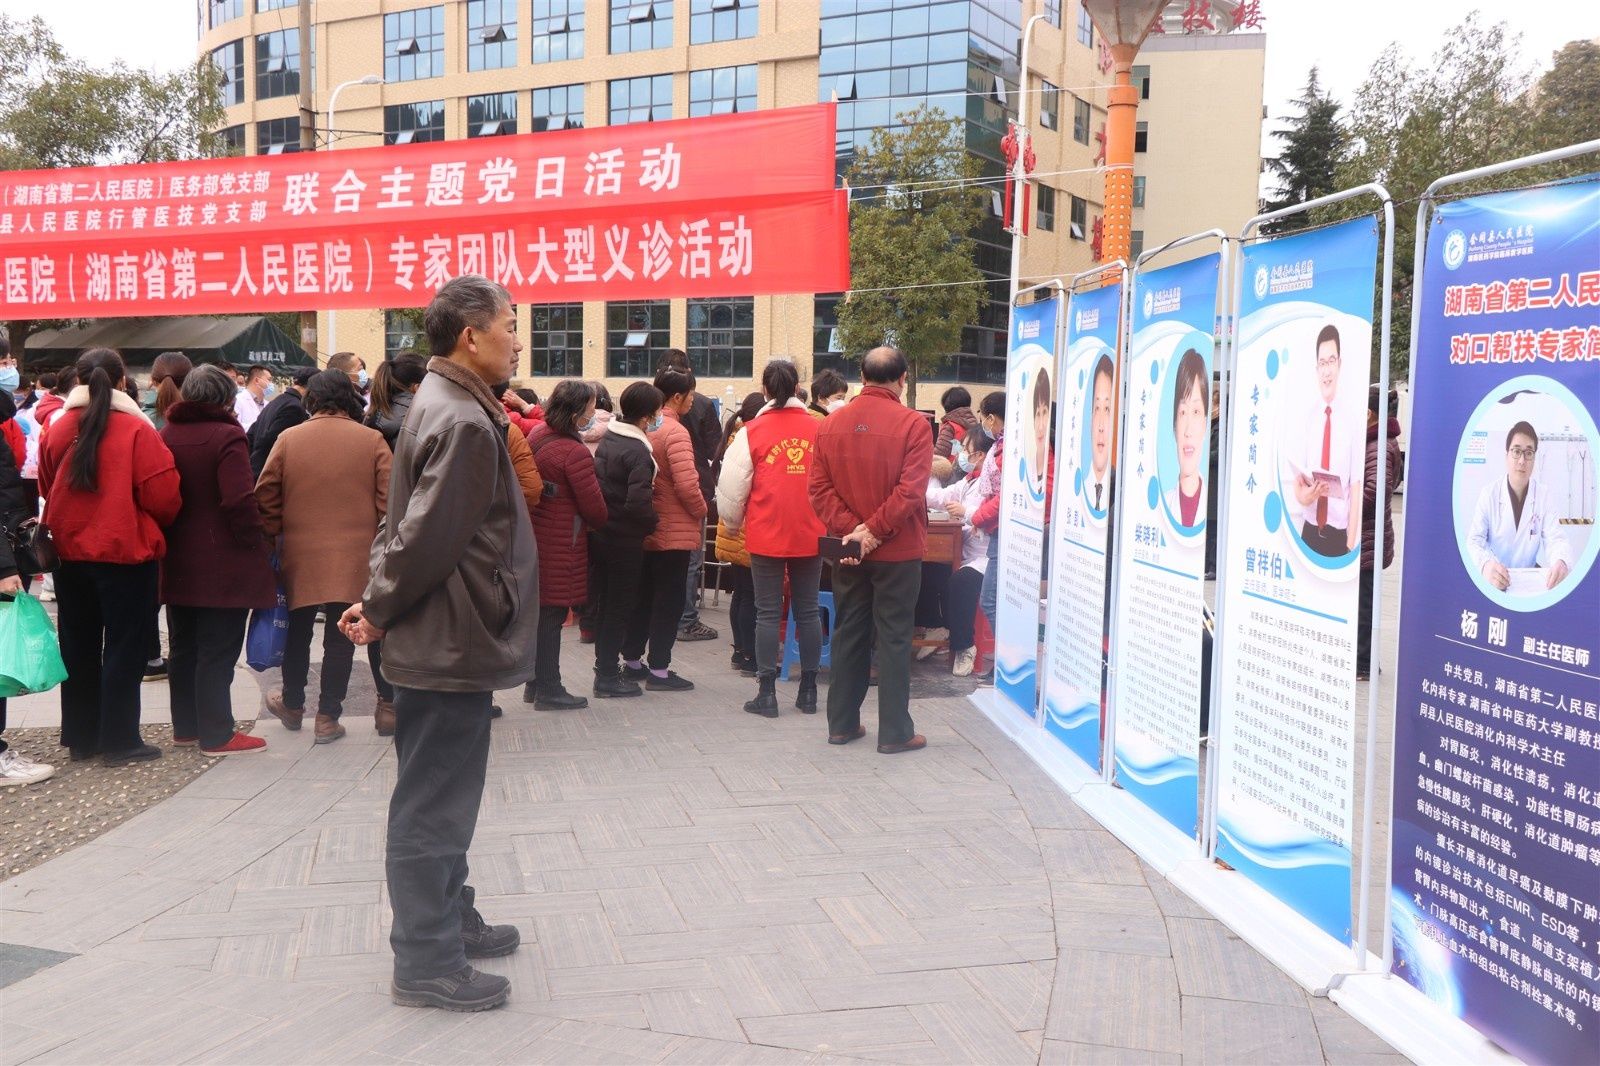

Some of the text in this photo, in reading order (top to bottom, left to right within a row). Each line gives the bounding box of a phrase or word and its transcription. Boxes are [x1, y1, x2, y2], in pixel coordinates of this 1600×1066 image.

[4, 170, 270, 206] （湖南省第二人民医院）医务部党支部
[283, 142, 682, 216] 联合主题党日活动
[0, 200, 268, 234] 县人民医院行管医技党支部
[0, 215, 753, 305] 医院（湖南省第二人民医院）专家团队大型义诊活动
[1444, 271, 1600, 317] 湖南省第二人民
[1460, 609, 1590, 668] 杨刚 副主任医师
[1444, 661, 1600, 721] 中共党员，湖南省第二人民医
[1419, 702, 1566, 767] 同县人民医院消化内科学术主任
[1436, 832, 1600, 925] 擅长开展消化道早癌及黏膜下肿
